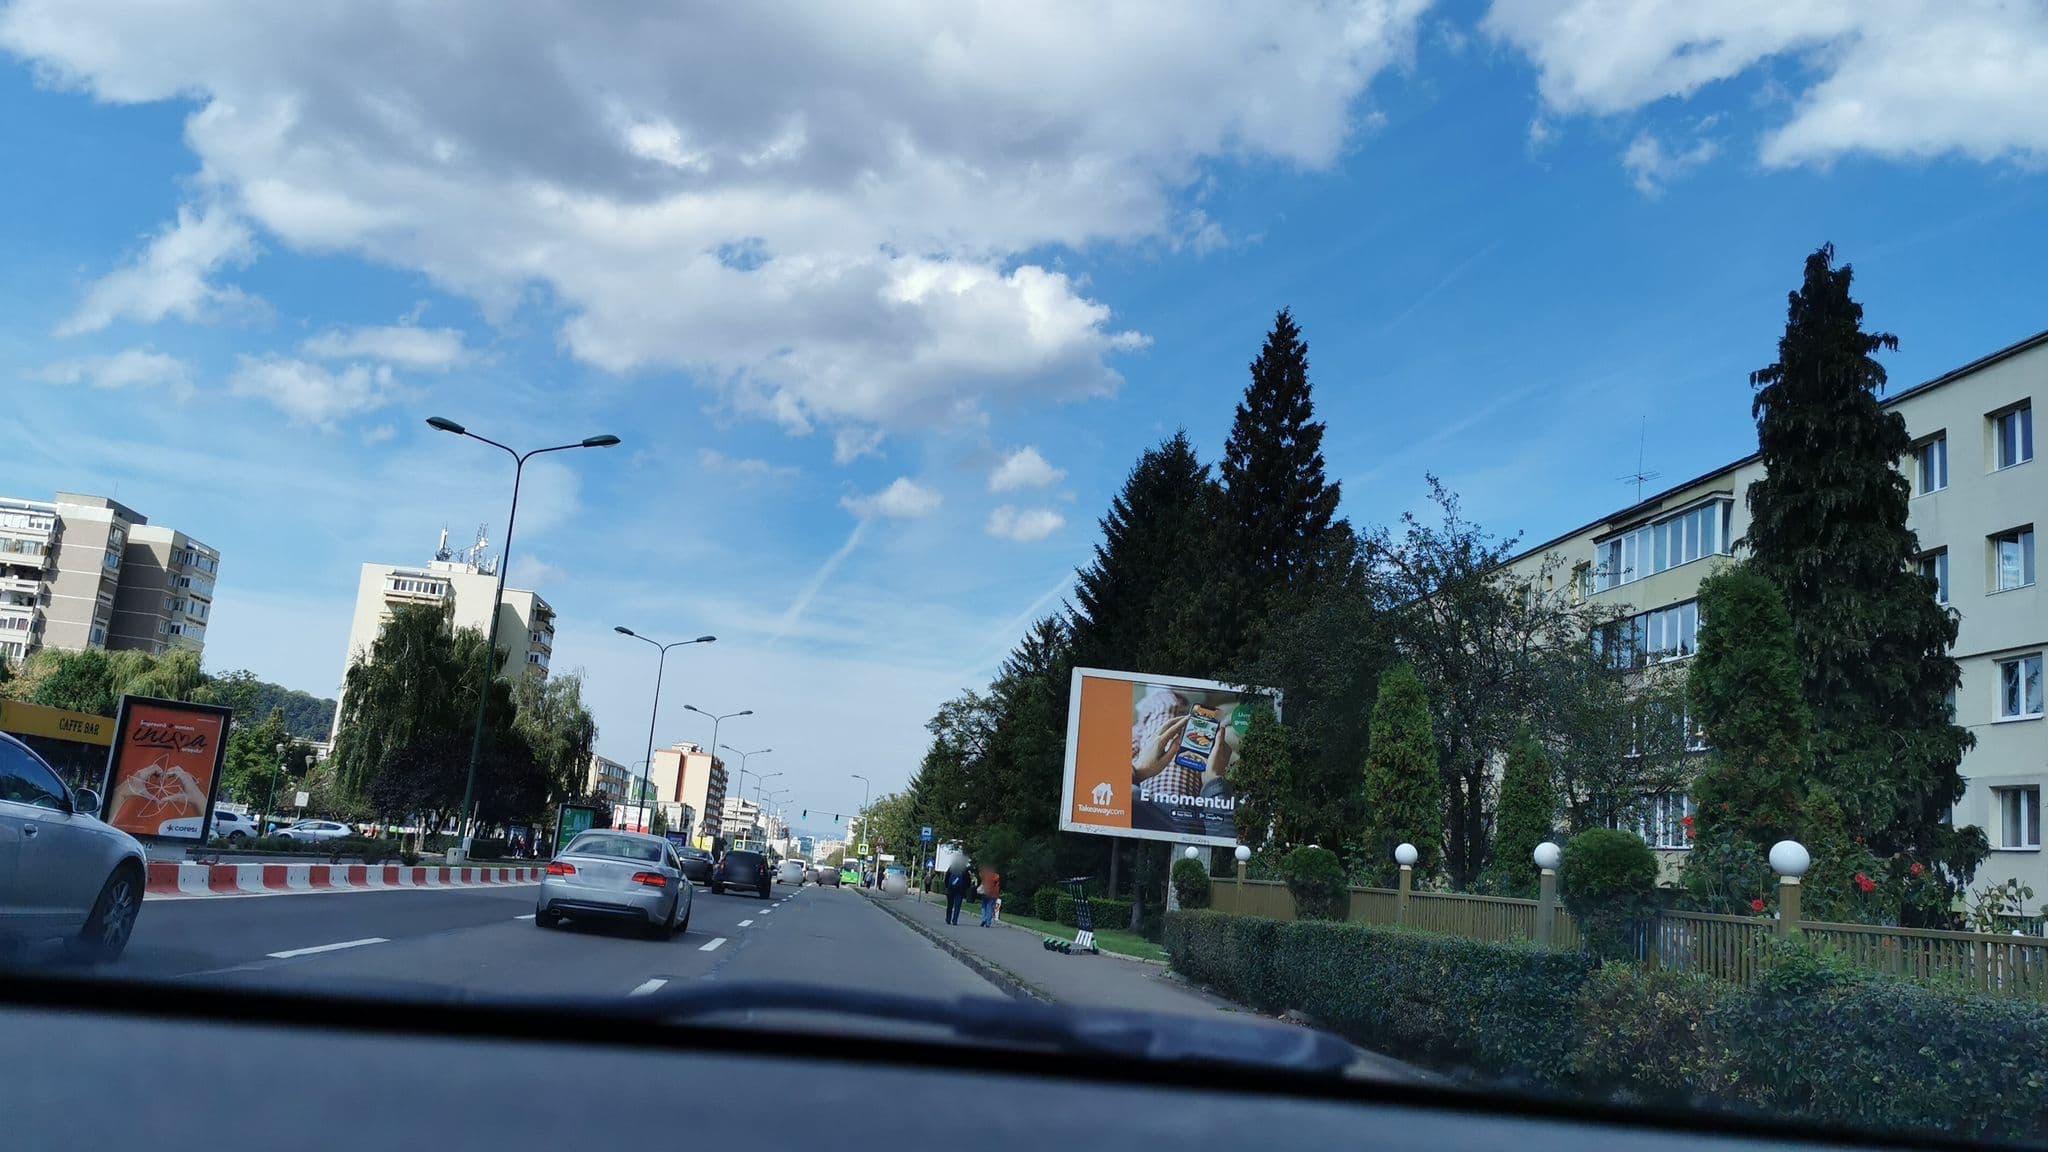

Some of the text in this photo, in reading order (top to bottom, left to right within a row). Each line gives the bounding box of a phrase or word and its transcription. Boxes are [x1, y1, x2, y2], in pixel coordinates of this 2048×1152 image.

[59, 718, 100, 736] CAFFE BAR
[1140, 788, 1150, 802] E
[1153, 791, 1235, 810] momentul
